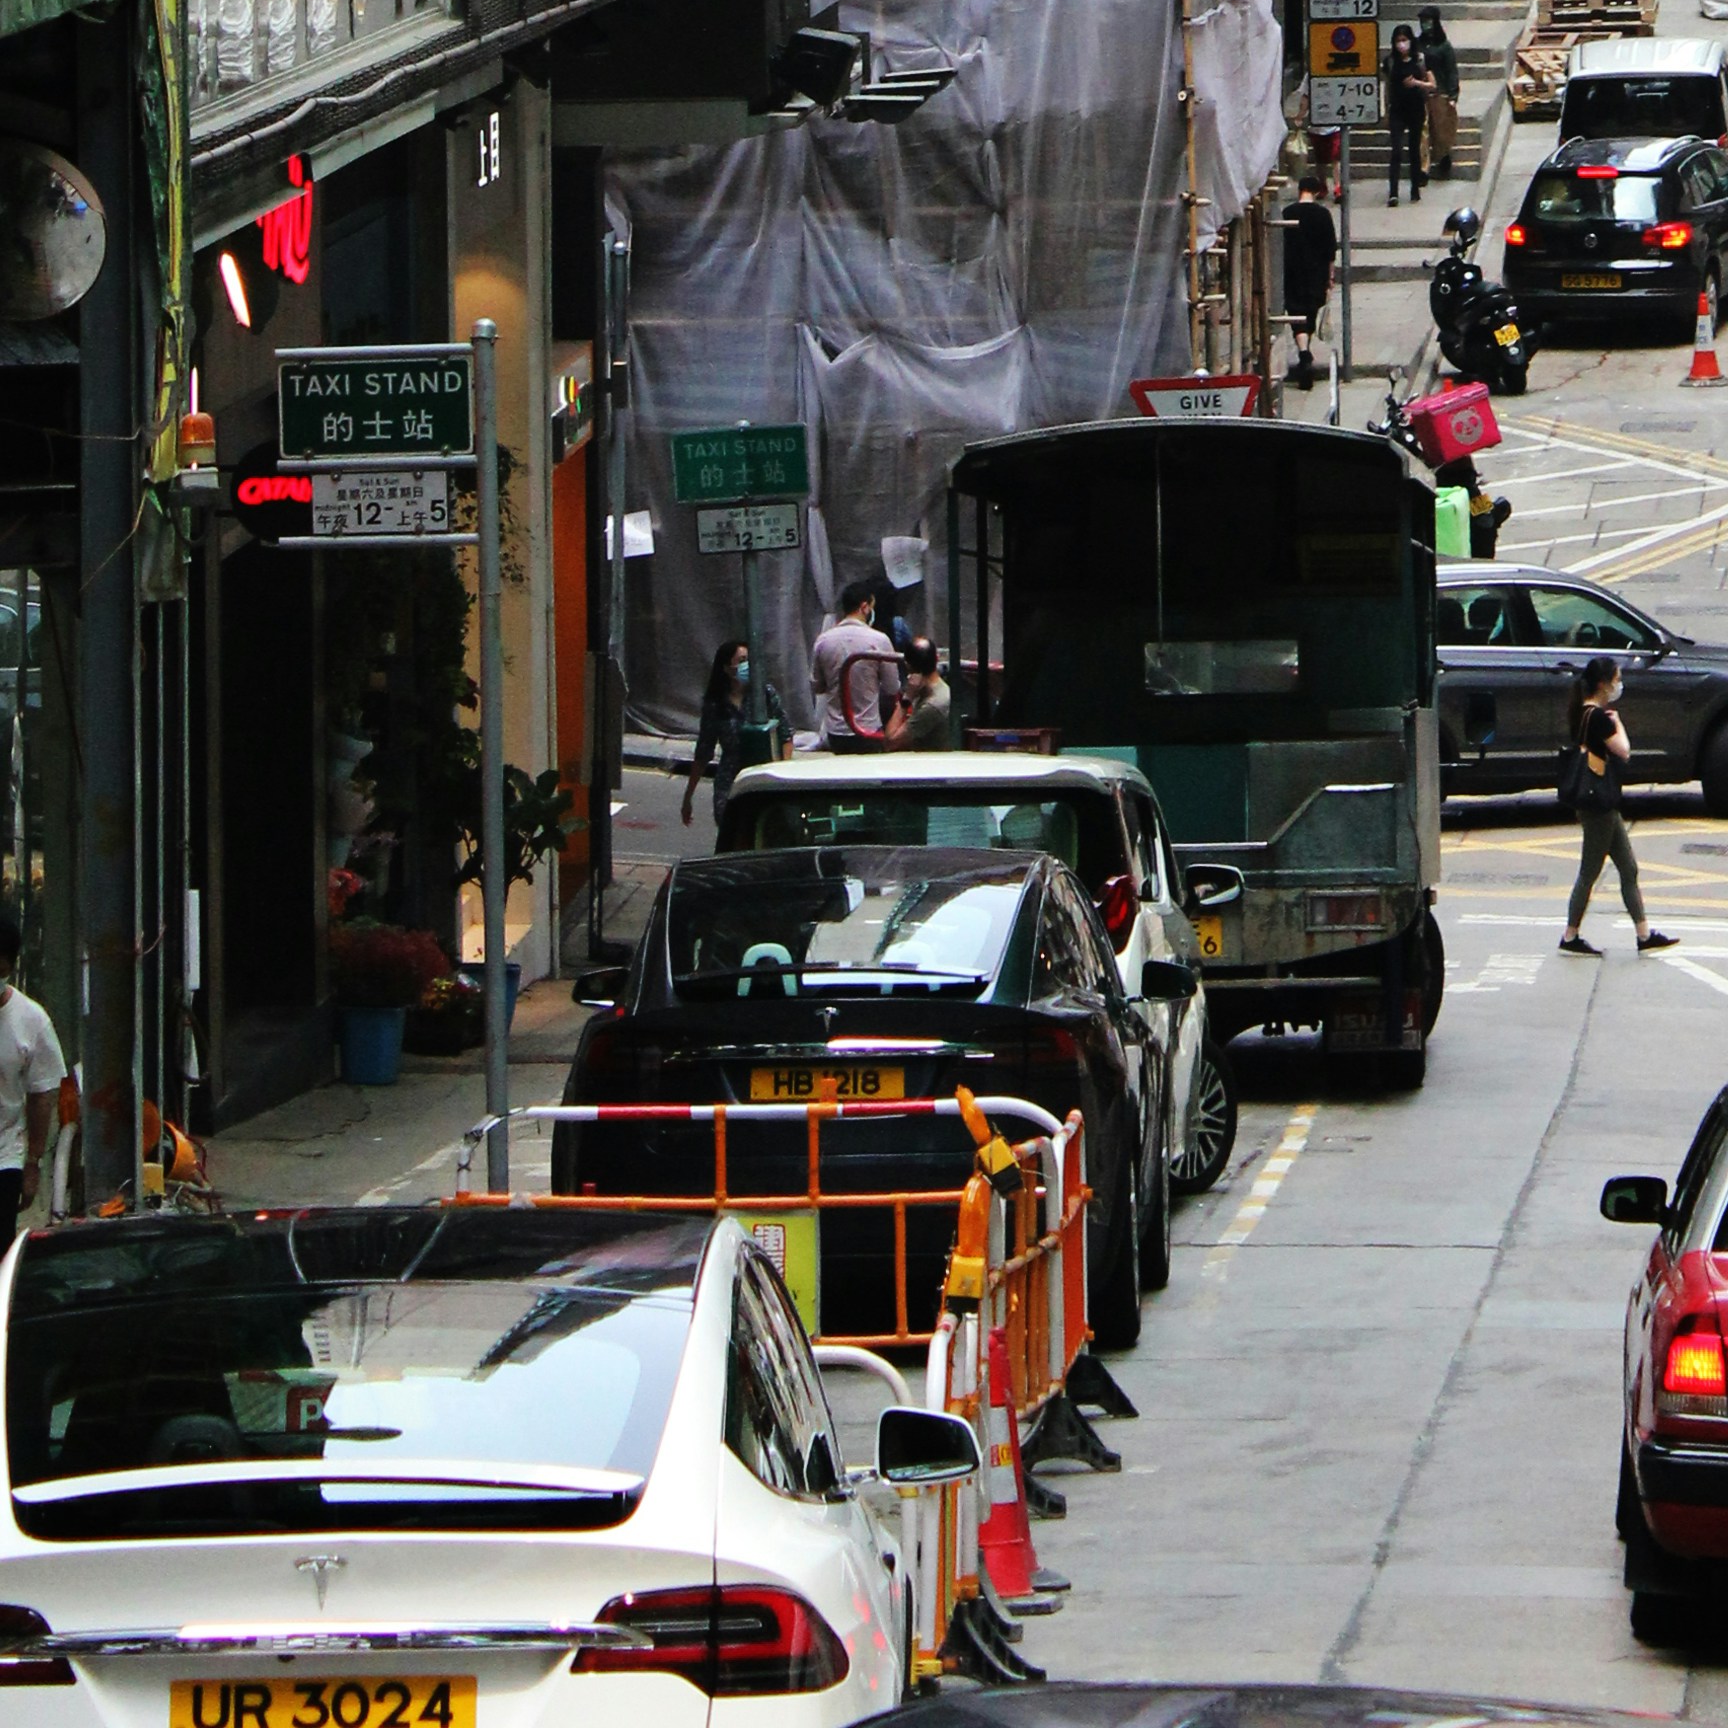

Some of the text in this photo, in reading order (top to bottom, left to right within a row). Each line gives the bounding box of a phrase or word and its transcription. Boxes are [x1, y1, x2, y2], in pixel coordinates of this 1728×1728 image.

[1337, 82, 1375, 97] 7-10
[290, 370, 462, 397] TAXI STAND
[1180, 394, 1222, 410] GIVE
[322, 409, 434, 442] 的士站
[683, 436, 797, 459] TAXI STAND
[430, 499, 446, 522] 5
[785, 528, 796, 543] 5
[773, 1069, 881, 1095] HB 218
[191, 1681, 454, 1728] UR 3024
